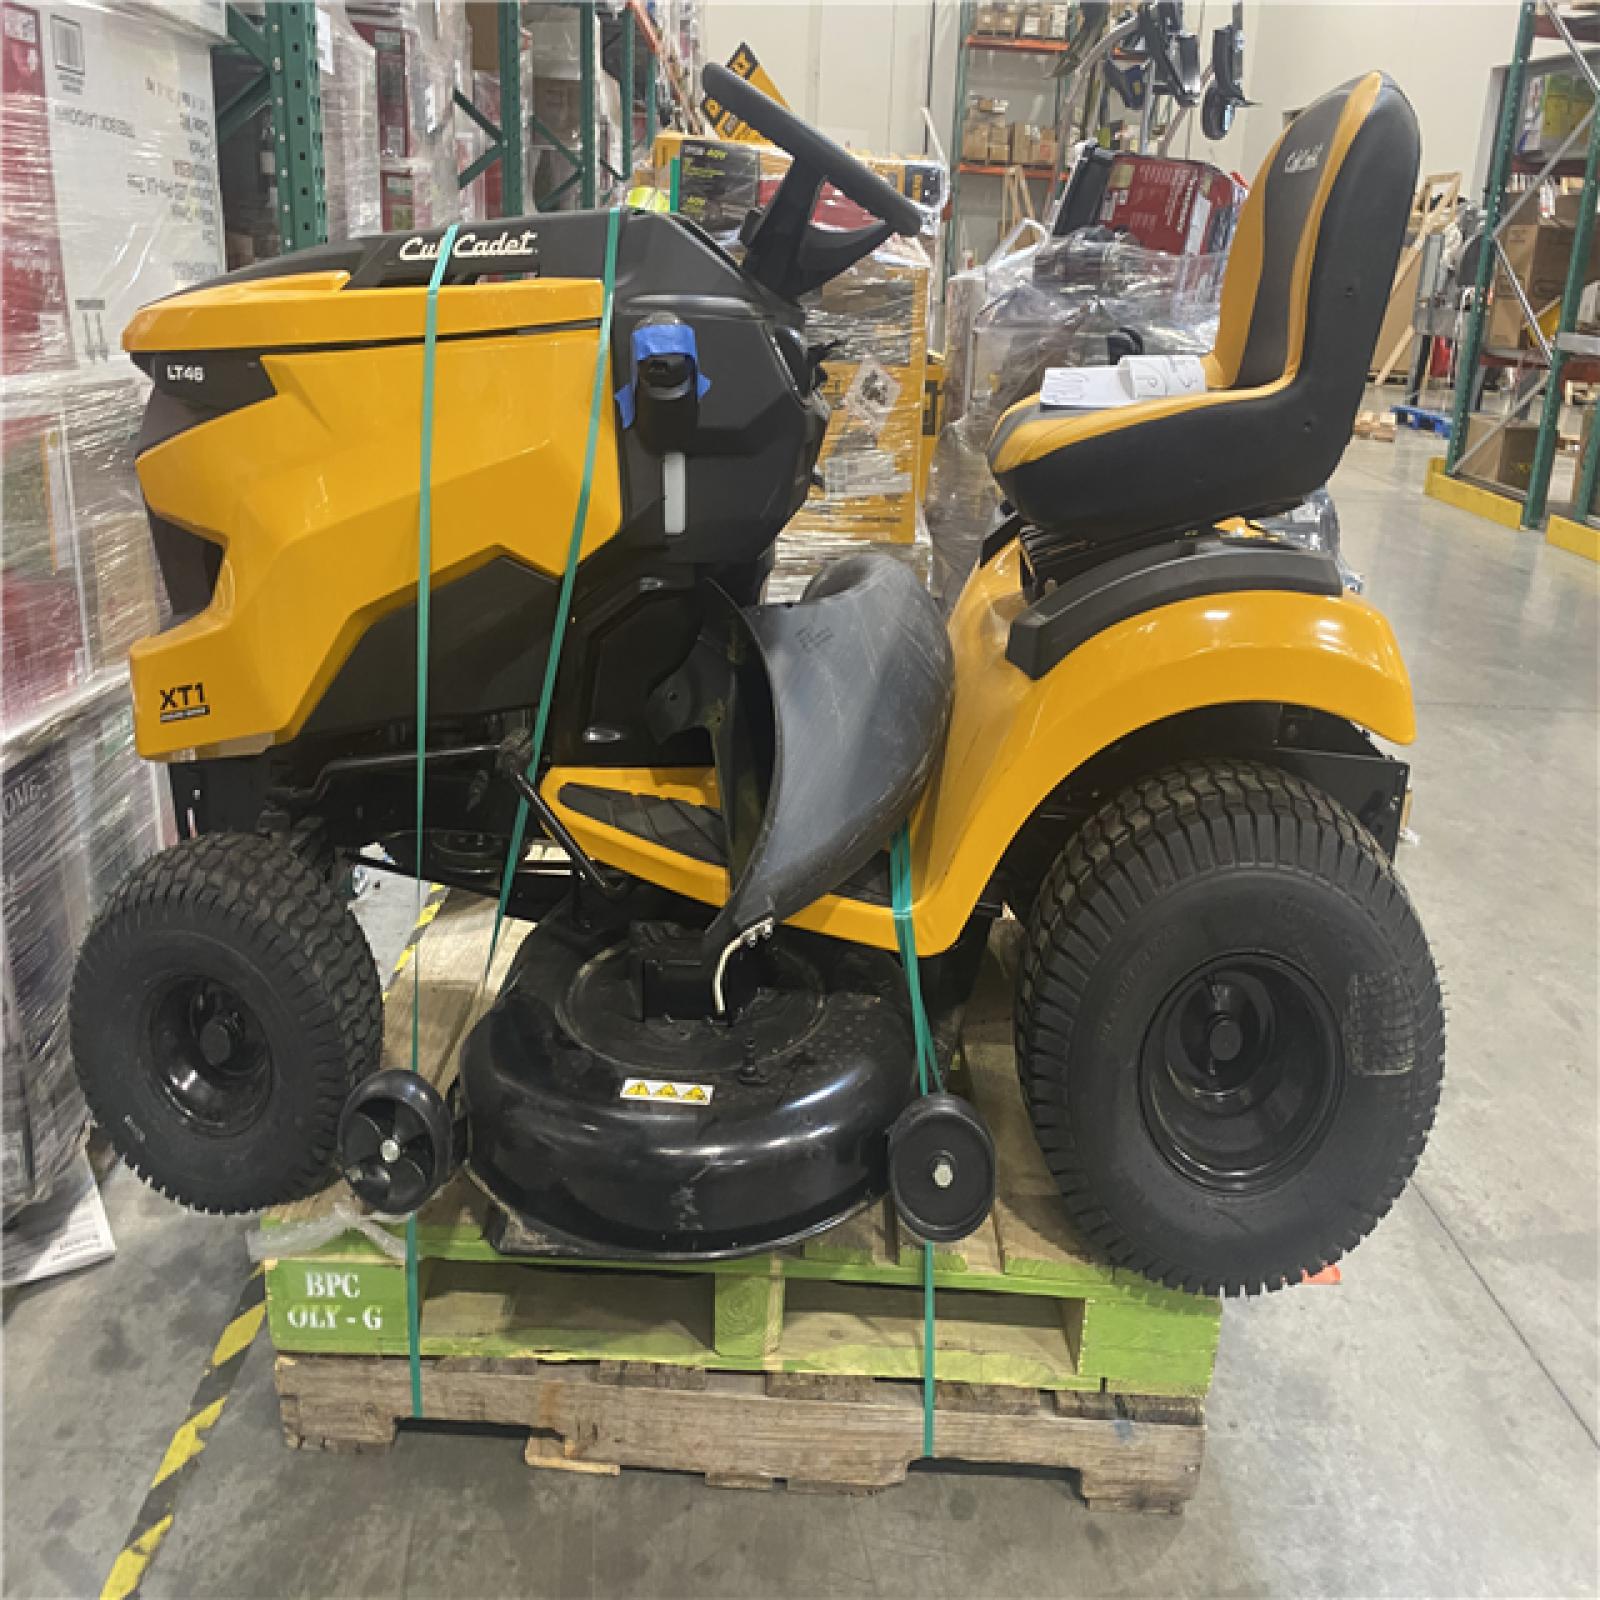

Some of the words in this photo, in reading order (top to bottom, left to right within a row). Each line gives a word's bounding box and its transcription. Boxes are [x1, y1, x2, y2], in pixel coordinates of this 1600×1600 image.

[399, 236, 447, 261] Cu
[452, 231, 537, 258] Cadet
[159, 682, 204, 710] XT1
[305, 1271, 361, 1298] BPC
[287, 1304, 342, 1329] OLY
[362, 1304, 383, 1331] G
